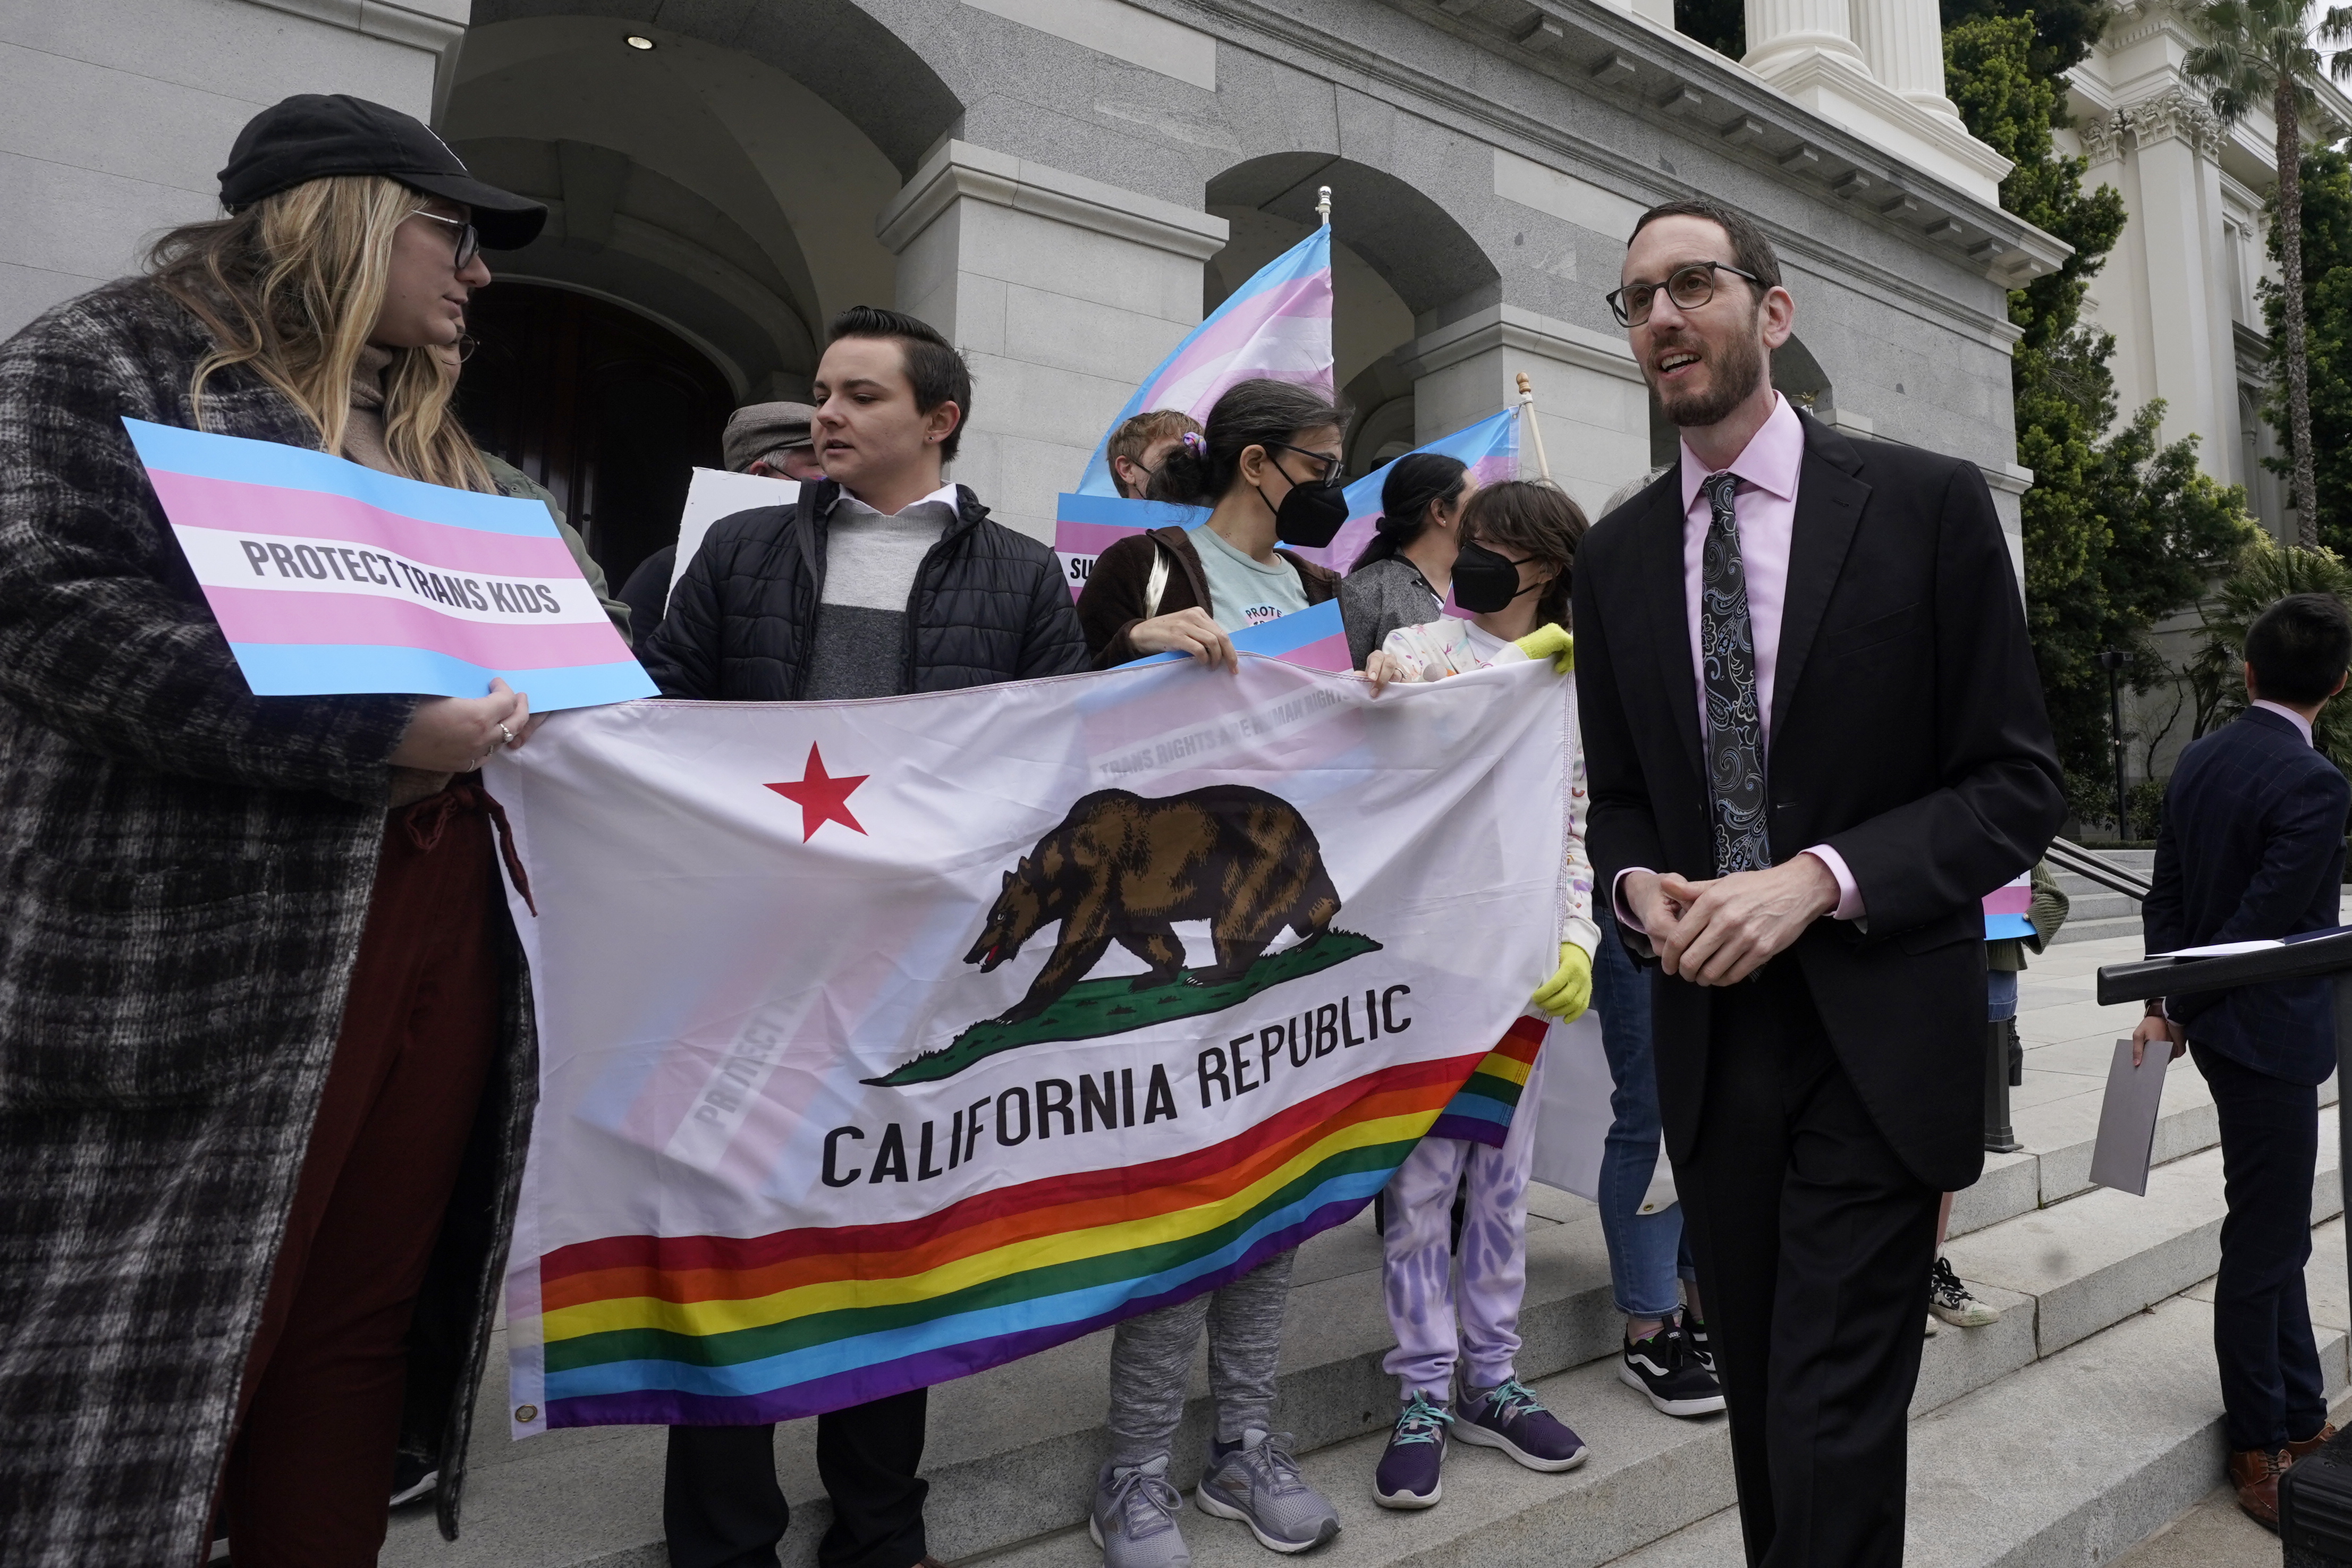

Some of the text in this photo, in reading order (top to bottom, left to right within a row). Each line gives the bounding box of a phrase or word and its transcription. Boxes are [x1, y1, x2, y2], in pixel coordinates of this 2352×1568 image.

[239, 540, 561, 614] PROTECT TRANS KIDS
[1070, 558, 1093, 579] SU
[1245, 606, 1282, 620] PROTE
[1155, 729, 1216, 764] RIGHTS
[822, 984, 1412, 1188] CALIFORNIA REPUBLIC
